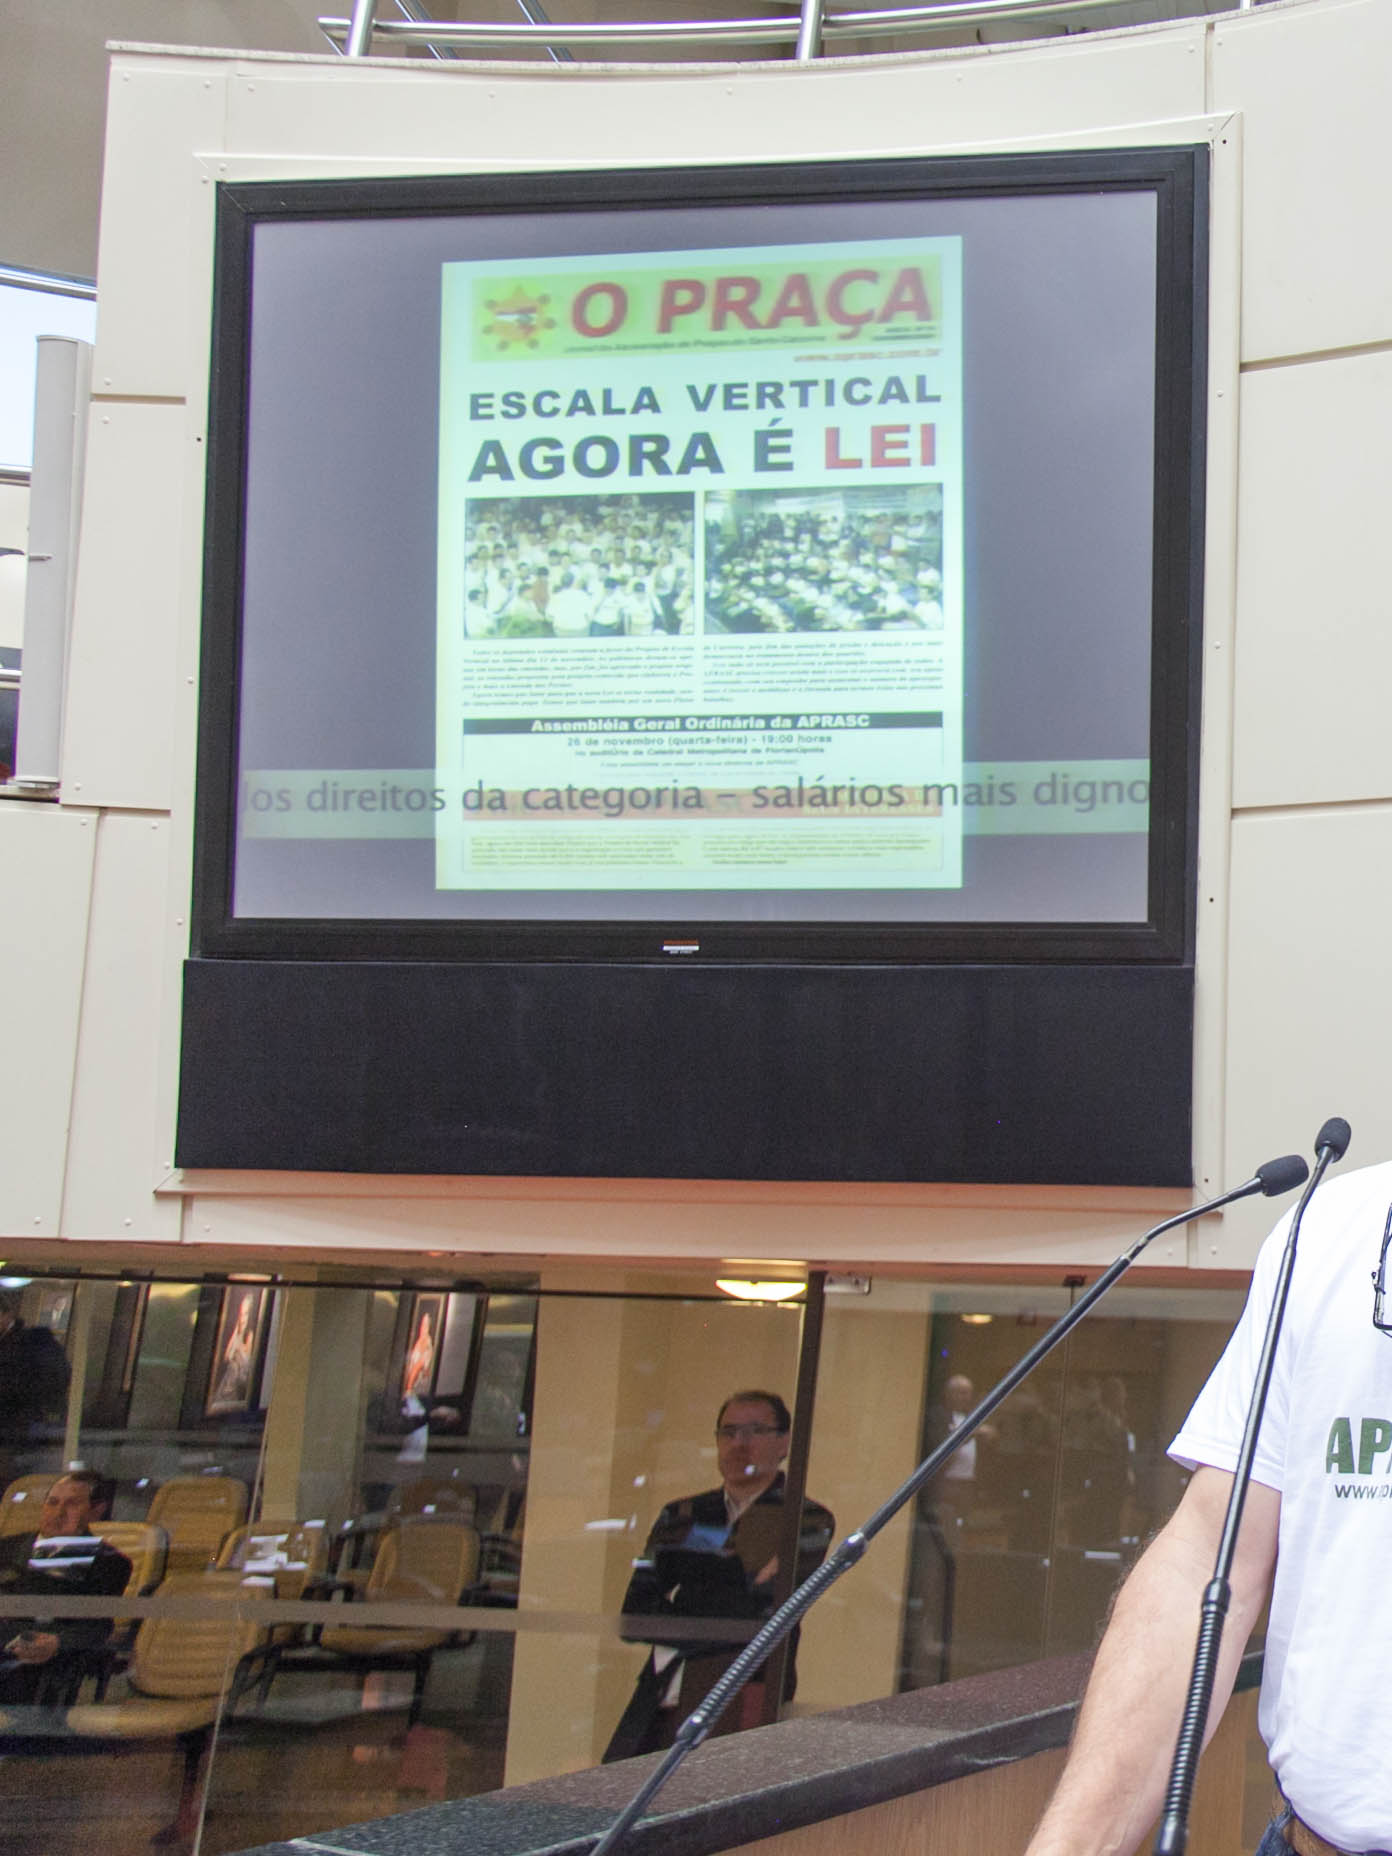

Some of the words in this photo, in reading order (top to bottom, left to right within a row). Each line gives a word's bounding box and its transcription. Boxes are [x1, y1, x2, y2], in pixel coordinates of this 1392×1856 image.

[572, 281, 629, 338] O
[656, 266, 934, 341] PRAÇA
[468, 386, 662, 421] ESCALA
[685, 374, 942, 412] VERTICAL
[467, 431, 726, 483] AGORA
[753, 417, 795, 473] É
[824, 422, 937, 470] LEI
[531, 717, 630, 733] Assembléia
[633, 717, 681, 731] Geral
[685, 715, 766, 730] Ordinária
[770, 714, 793, 729] da
[796, 713, 871, 728] APRASC
[567, 736, 581, 747] 26
[585, 735, 600, 747] de
[603, 735, 664, 747] novembro
[667, 734, 748, 747] (quarta-feira)
[762, 734, 794, 745] 19:00
[797, 733, 832, 744] horas
[306, 780, 446, 813] direitos
[462, 779, 508, 811] da
[522, 778, 704, 818] categoria
[751, 774, 905, 808] salários
[922, 774, 1017, 807] mais
